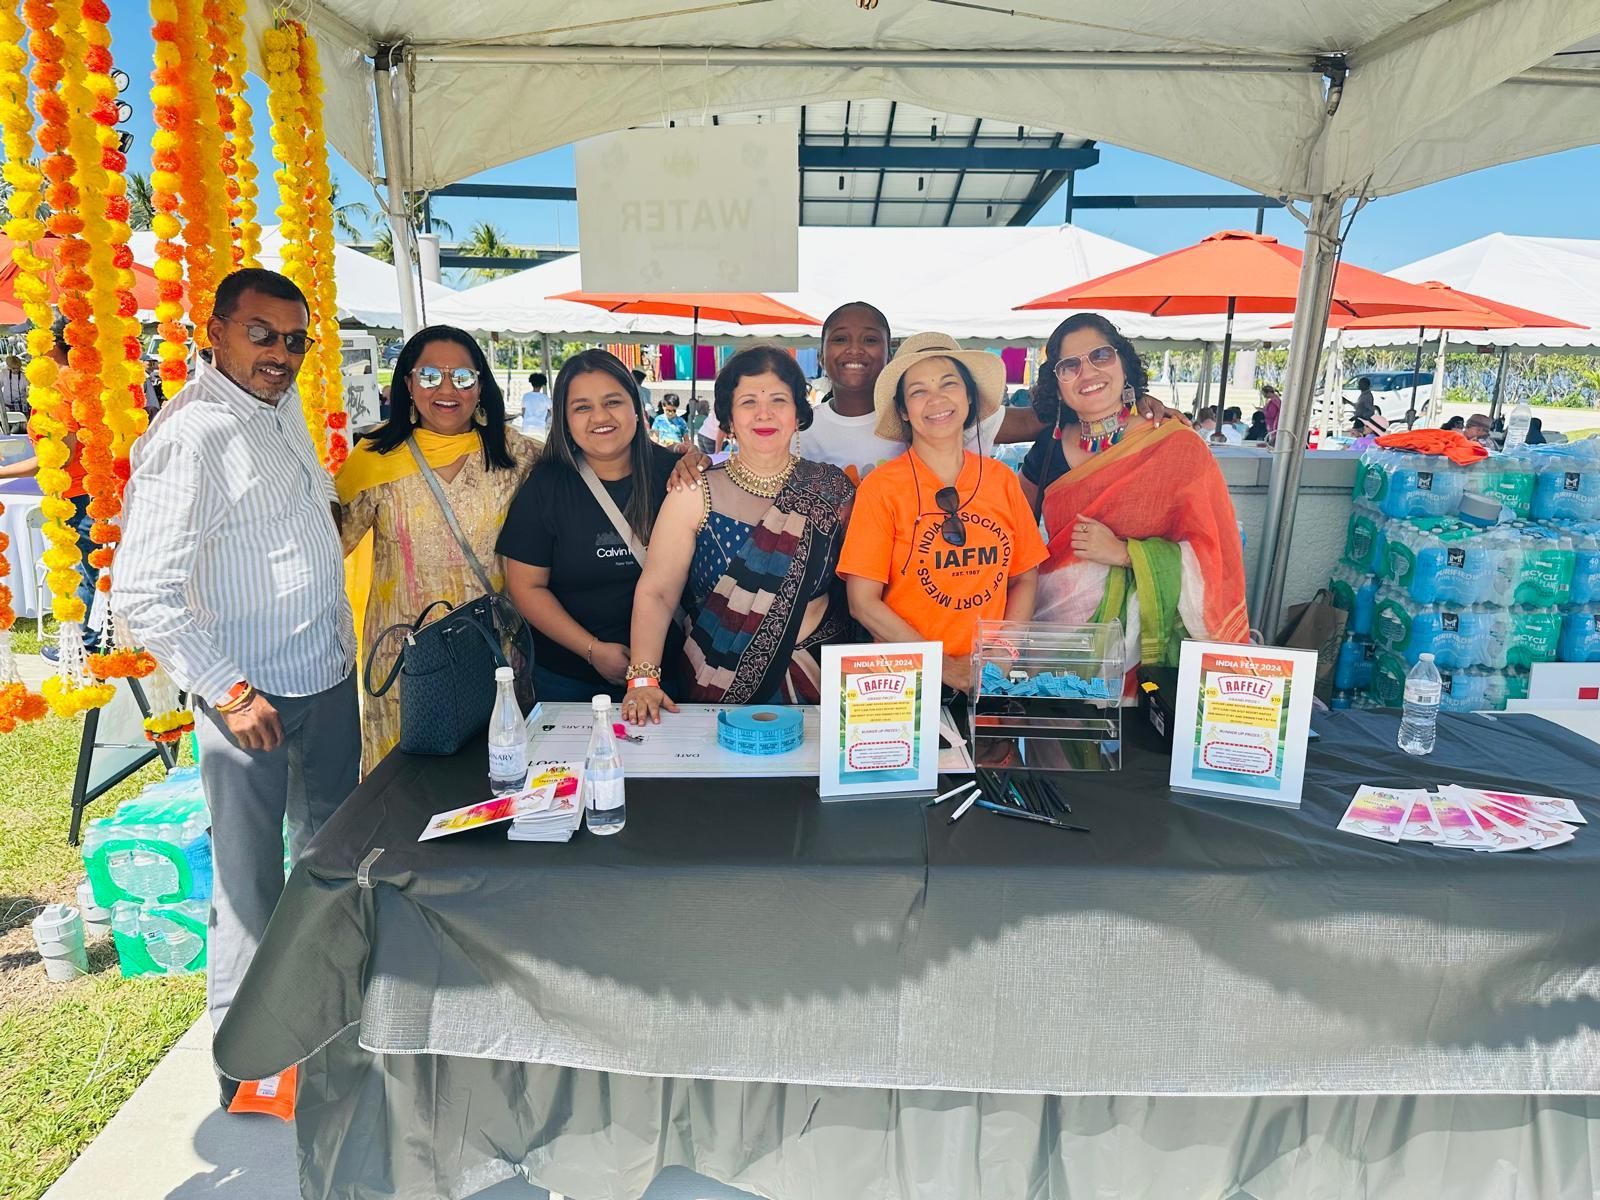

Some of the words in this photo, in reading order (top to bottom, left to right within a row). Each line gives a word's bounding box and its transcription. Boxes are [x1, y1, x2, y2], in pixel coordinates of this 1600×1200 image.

[918, 522, 942, 554] INDIA
[944, 512, 1011, 567] SOCIATION
[596, 547, 628, 558] Calvin
[935, 546, 998, 570] IAFM
[917, 567, 952, 607] MYERS
[993, 572, 1004, 591] OF
[954, 589, 992, 610] FORT
[1215, 660, 1239, 668] INDIA
[1261, 664, 1282, 672] 2024
[864, 679, 901, 692] RAFFLE
[1225, 681, 1266, 695] RAFFLE
